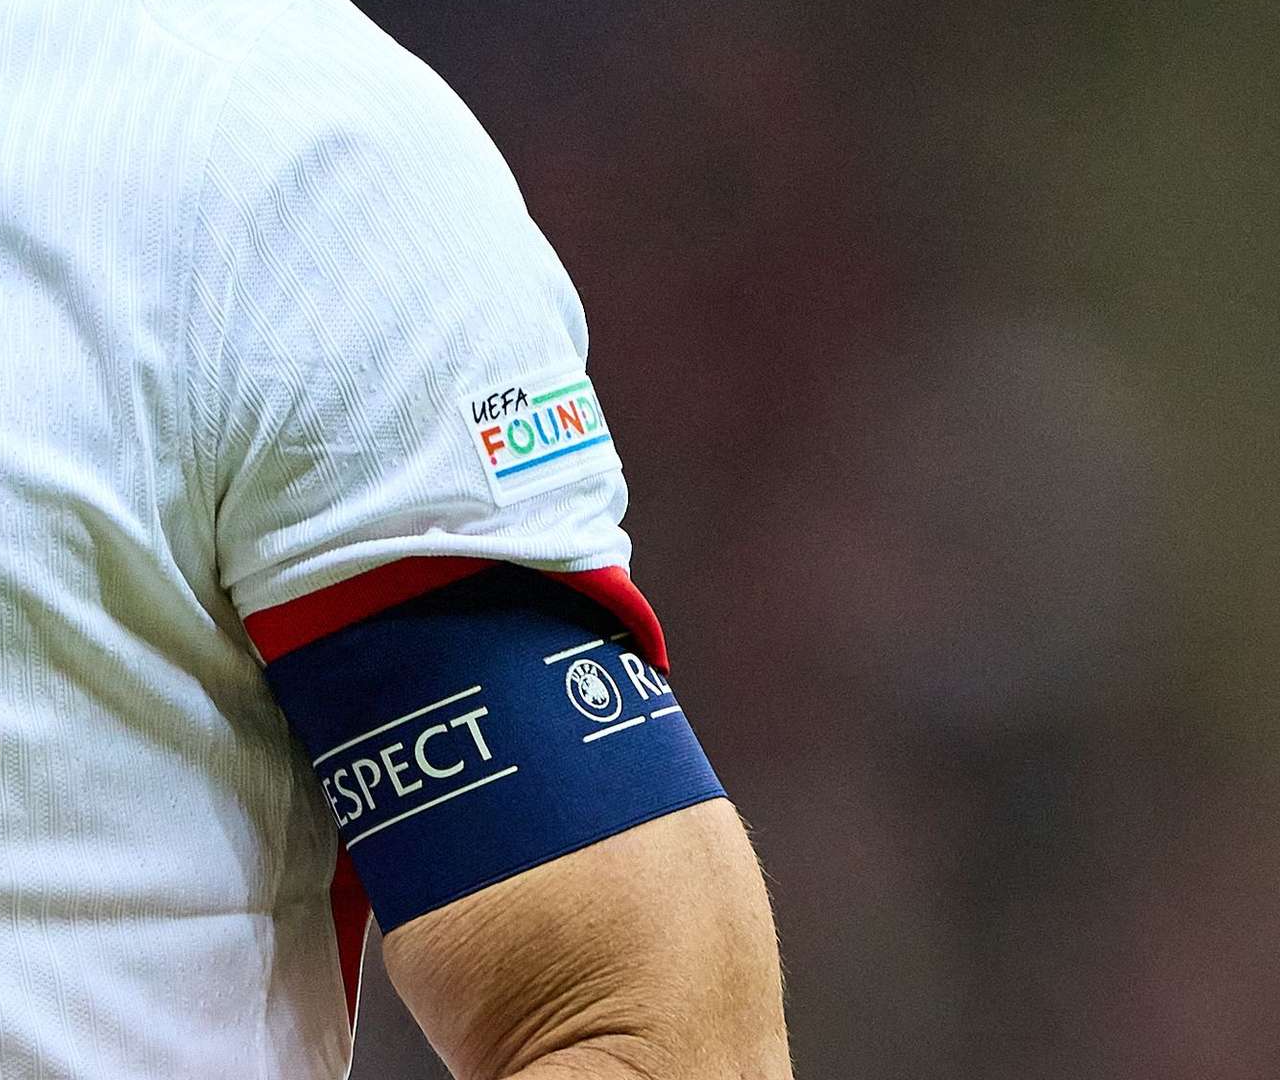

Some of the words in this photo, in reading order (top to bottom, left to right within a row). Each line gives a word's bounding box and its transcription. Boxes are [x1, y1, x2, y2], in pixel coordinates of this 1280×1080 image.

[471, 387, 529, 424] UEFA
[480, 395, 604, 466] FOUND
[321, 706, 493, 828] ESPECT
